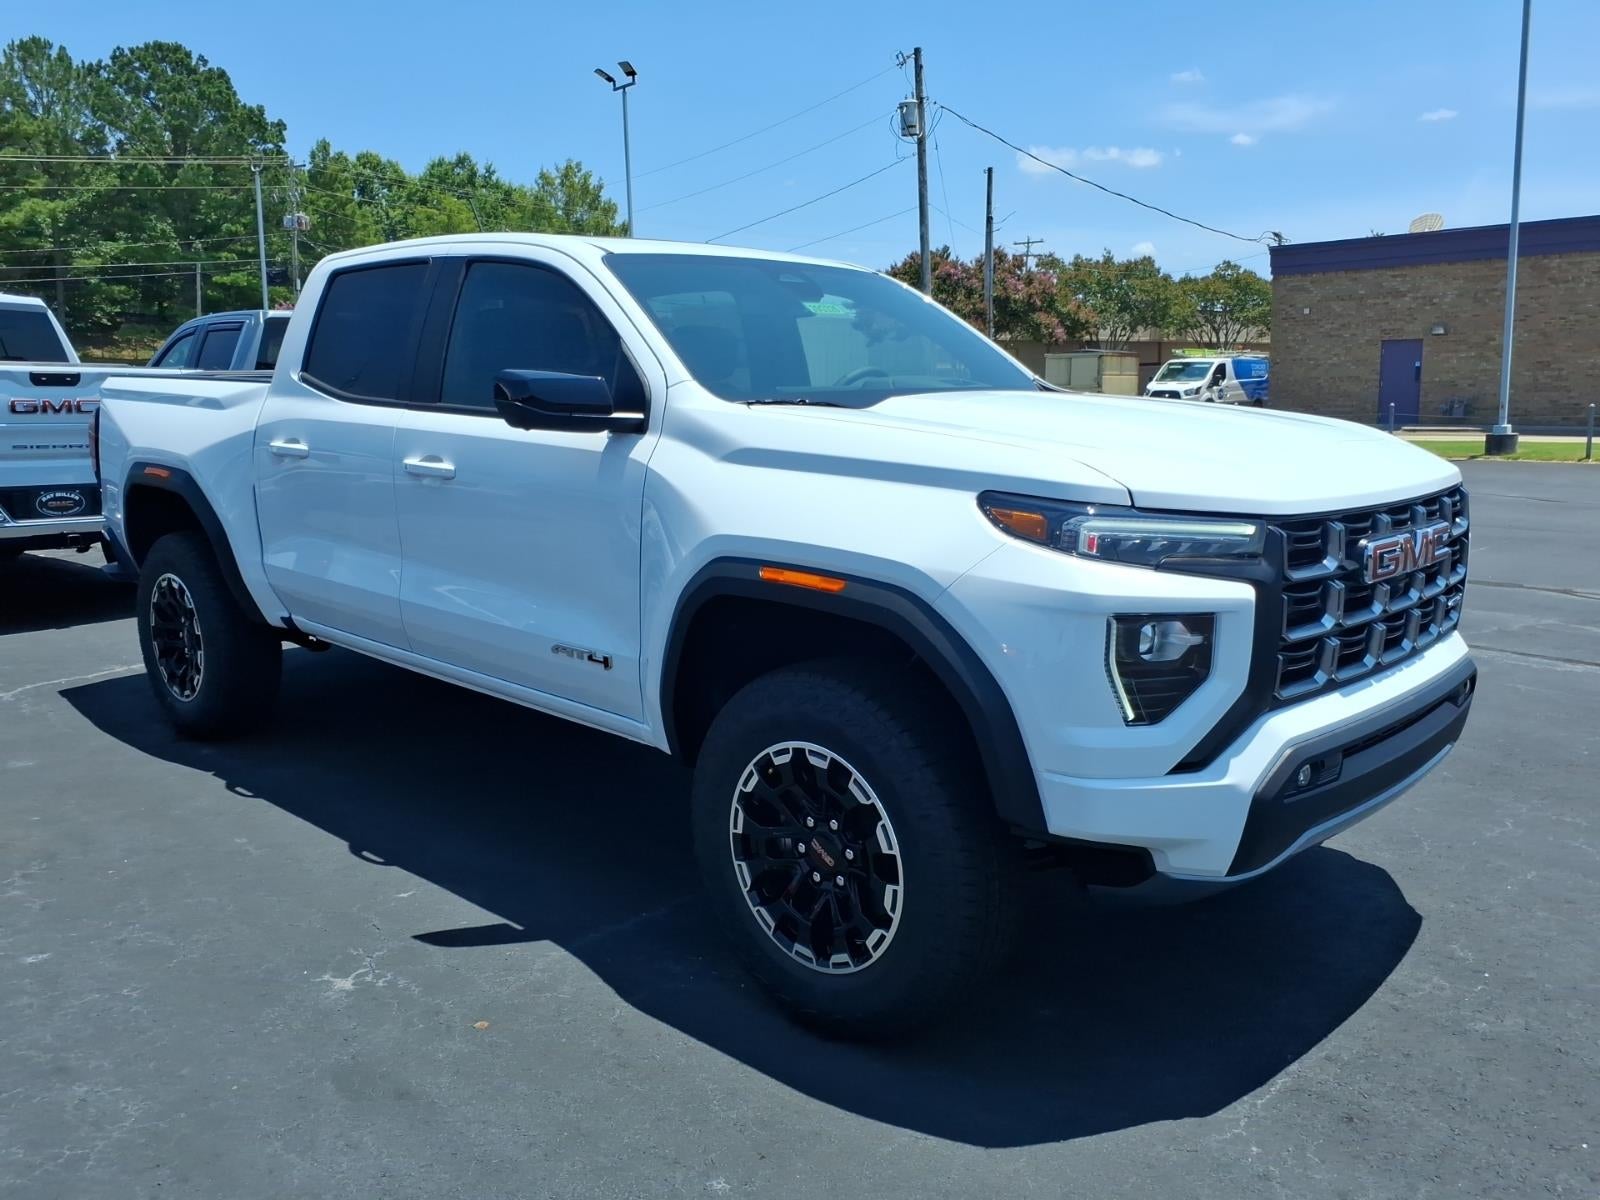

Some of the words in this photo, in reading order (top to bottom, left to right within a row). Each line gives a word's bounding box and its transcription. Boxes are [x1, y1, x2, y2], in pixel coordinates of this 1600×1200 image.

[9, 399, 101, 414] GMC
[47, 500, 74, 508] GMC
[1364, 521, 1452, 583] GMC
[551, 643, 613, 671] AT4
[811, 838, 835, 867] GMC
